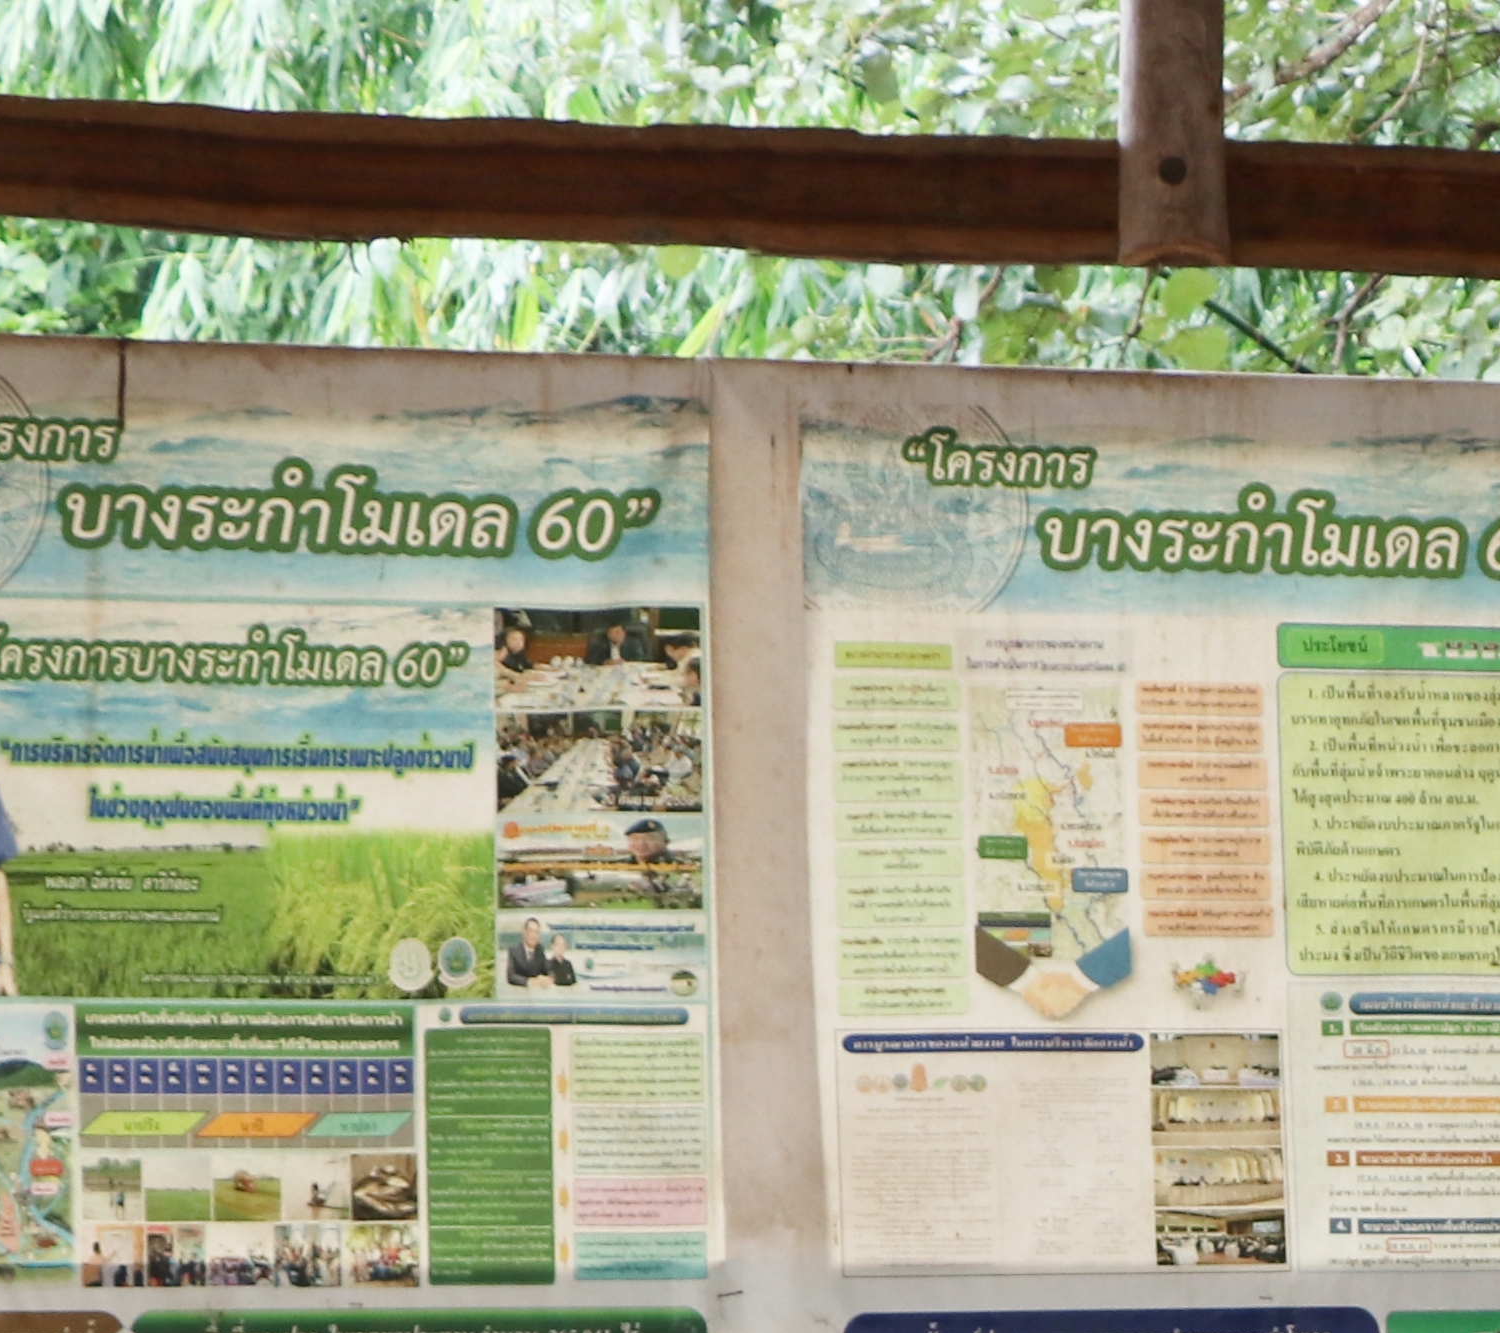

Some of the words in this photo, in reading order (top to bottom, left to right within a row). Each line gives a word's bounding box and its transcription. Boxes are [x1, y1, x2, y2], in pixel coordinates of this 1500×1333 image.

[907, 432, 1092, 486] “โครงการ
[65, 467, 506, 549] บางระกำโมเดล
[538, 497, 654, 554] 60”
[1045, 488, 1462, 572] บางระกำโมเดล
[398, 645, 467, 682] 60”
[1302, 636, 1368, 656] ประโยชน์
